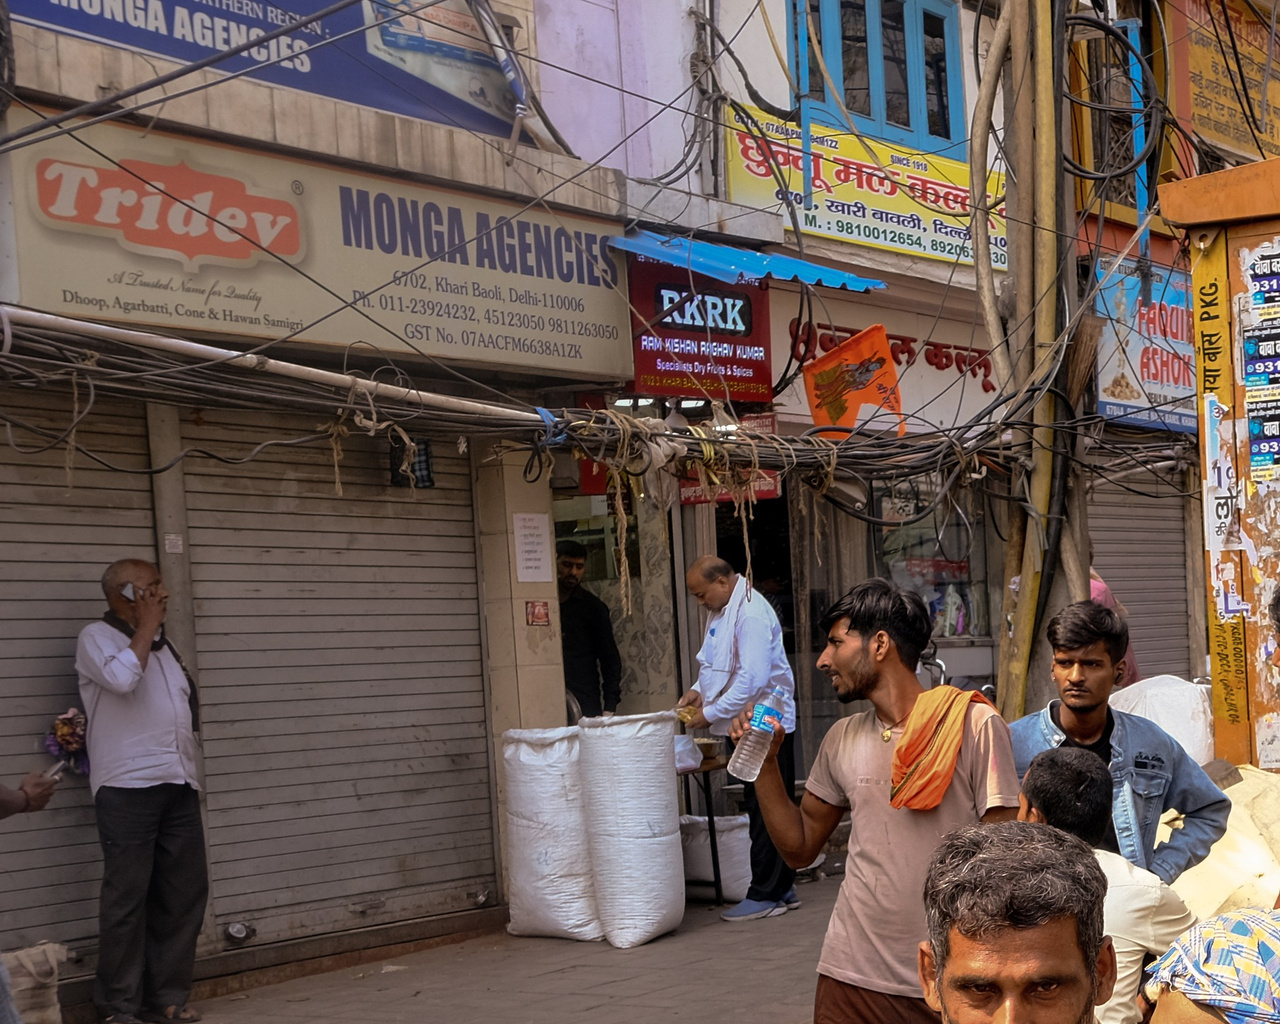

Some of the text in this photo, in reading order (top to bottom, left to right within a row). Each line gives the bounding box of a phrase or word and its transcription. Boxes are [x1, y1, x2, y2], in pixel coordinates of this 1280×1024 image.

[173, 9, 311, 73] AGENCIES
[832, 156, 900, 197] मल
[890, 154, 928, 172] SINCE 1918
[44, 163, 291, 249] Tridev
[825, 198, 867, 219] खारी
[871, 208, 928, 233] बावली,
[339, 185, 619, 290] MONGA AGENCIES
[804, 213, 822, 229] M.
[836, 219, 927, 251] 9810012654,
[62, 290, 304, 332] Dhoop, Agarbatti, Cone & Hawan Samigri
[170, 279, 206, 295] Name
[204, 280, 222, 306] for
[393, 270, 585, 313] 6702, Khari Baoli, Delhi-110006
[660, 288, 746, 332] RKRK
[1200, 277, 1219, 322] PKG.
[352, 290, 619, 340] Ph. 011-23924232, 45123050 9811263050
[404, 322, 431, 342] GST
[436, 327, 458, 345] No.
[641, 335, 765, 361] RAM KISHAN RAGHAV KUMAR
[656, 358, 693, 373] Specialists
[694, 361, 705, 375] Dry
[732, 365, 753, 378] Spices
[1140, 346, 1194, 388] ASHOK
